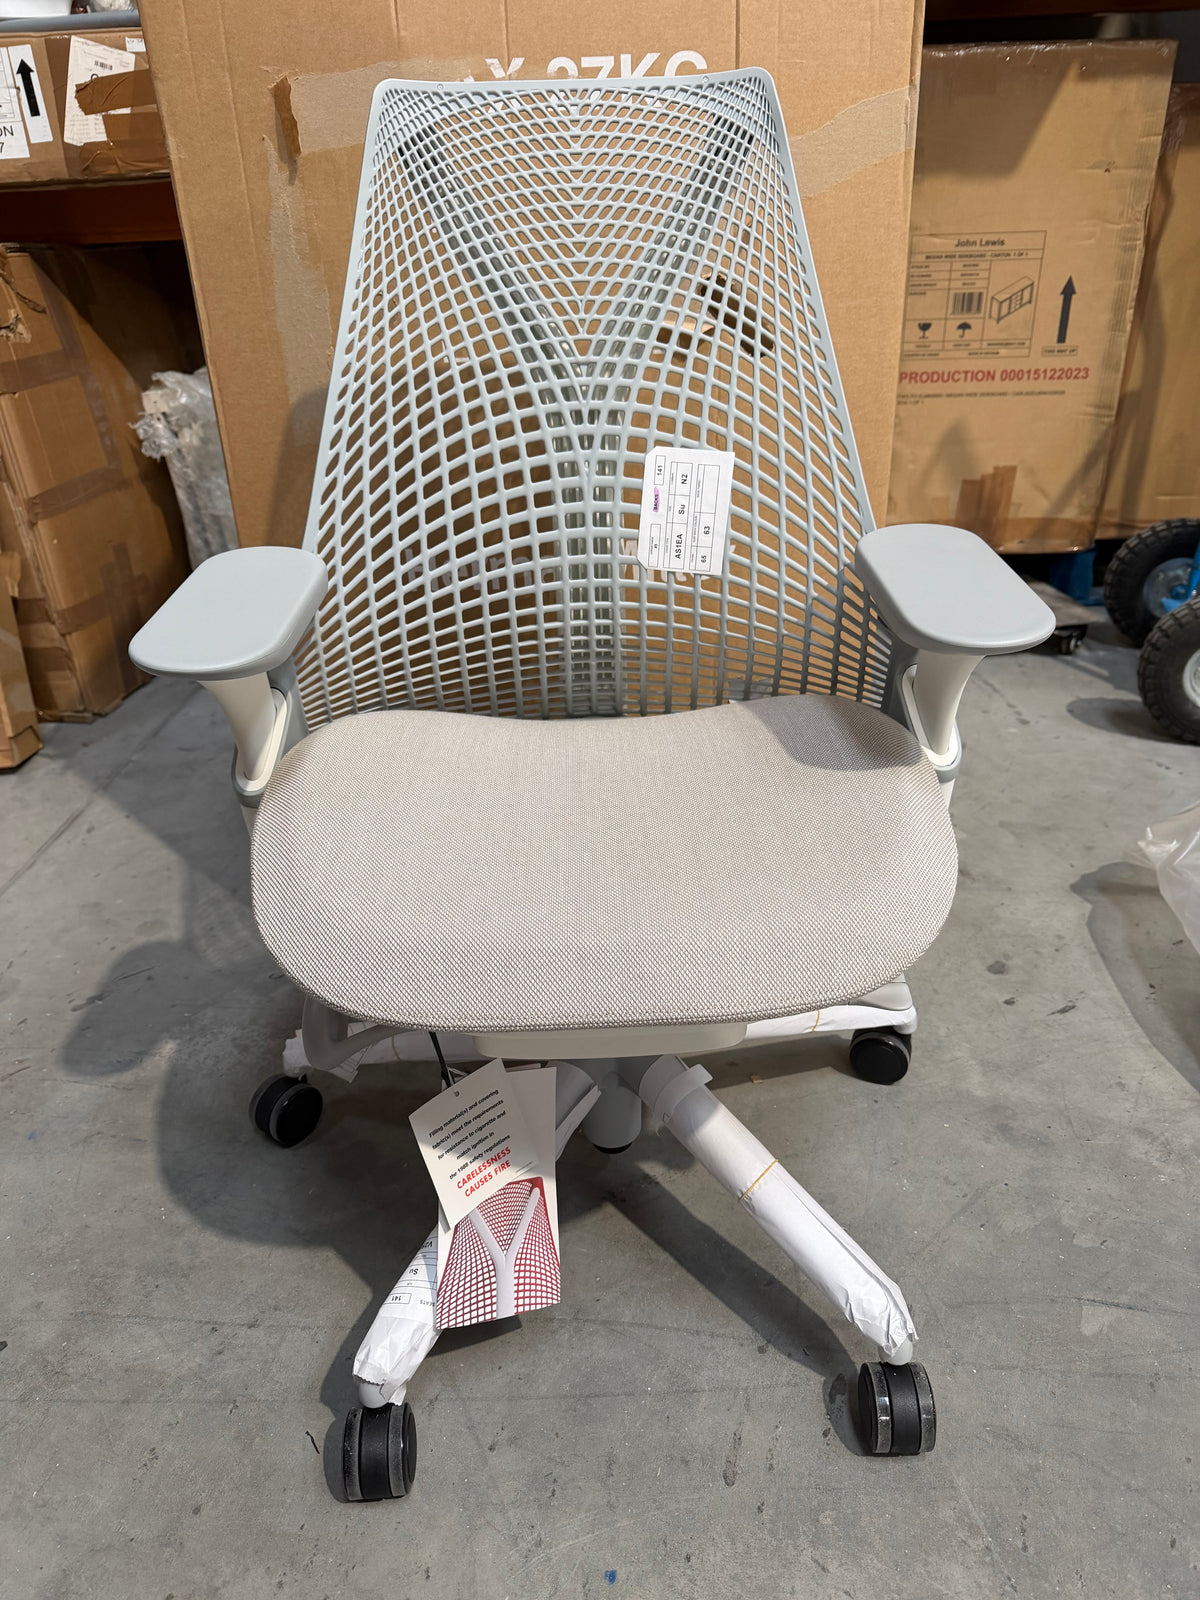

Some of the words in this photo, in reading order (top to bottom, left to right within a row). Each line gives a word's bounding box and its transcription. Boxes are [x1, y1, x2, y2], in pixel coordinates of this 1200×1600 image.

[0, 125, 14, 137] N
[955, 238, 977, 248] John
[979, 238, 1005, 247] Lewis
[900, 369, 996, 384] PRODUCTION
[1000, 367, 1090, 382] 00015122023
[681, 474, 688, 485] N2
[678, 504, 685, 515] Su
[703, 525, 711, 535] 63
[675, 533, 683, 559] AS1EA
[429, 1126, 443, 1138] Filling
[443, 1108, 468, 1128] material(s)
[468, 1101, 478, 1111] and
[478, 1089, 499, 1104] covering
[432, 1133, 452, 1150] fabric(s)
[451, 1125, 463, 1136] meet
[463, 1119, 472, 1128] the
[472, 1099, 504, 1122] requirements
[437, 1152, 445, 1160] for
[445, 1135, 469, 1155] resistance
[468, 1130, 475, 1138] to
[474, 1117, 497, 1134] cigarette
[496, 1110, 506, 1119] and
[457, 1147, 471, 1160] match
[471, 1135, 489, 1150] ignition
[457, 1161, 469, 1172] 1988
[469, 1153, 484, 1165] safety
[483, 1134, 510, 1154] regulations
[457, 1146, 511, 1189] CARELESSNESS
[464, 1172, 493, 1197] CAUSES
[493, 1160, 511, 1175] FIRE
